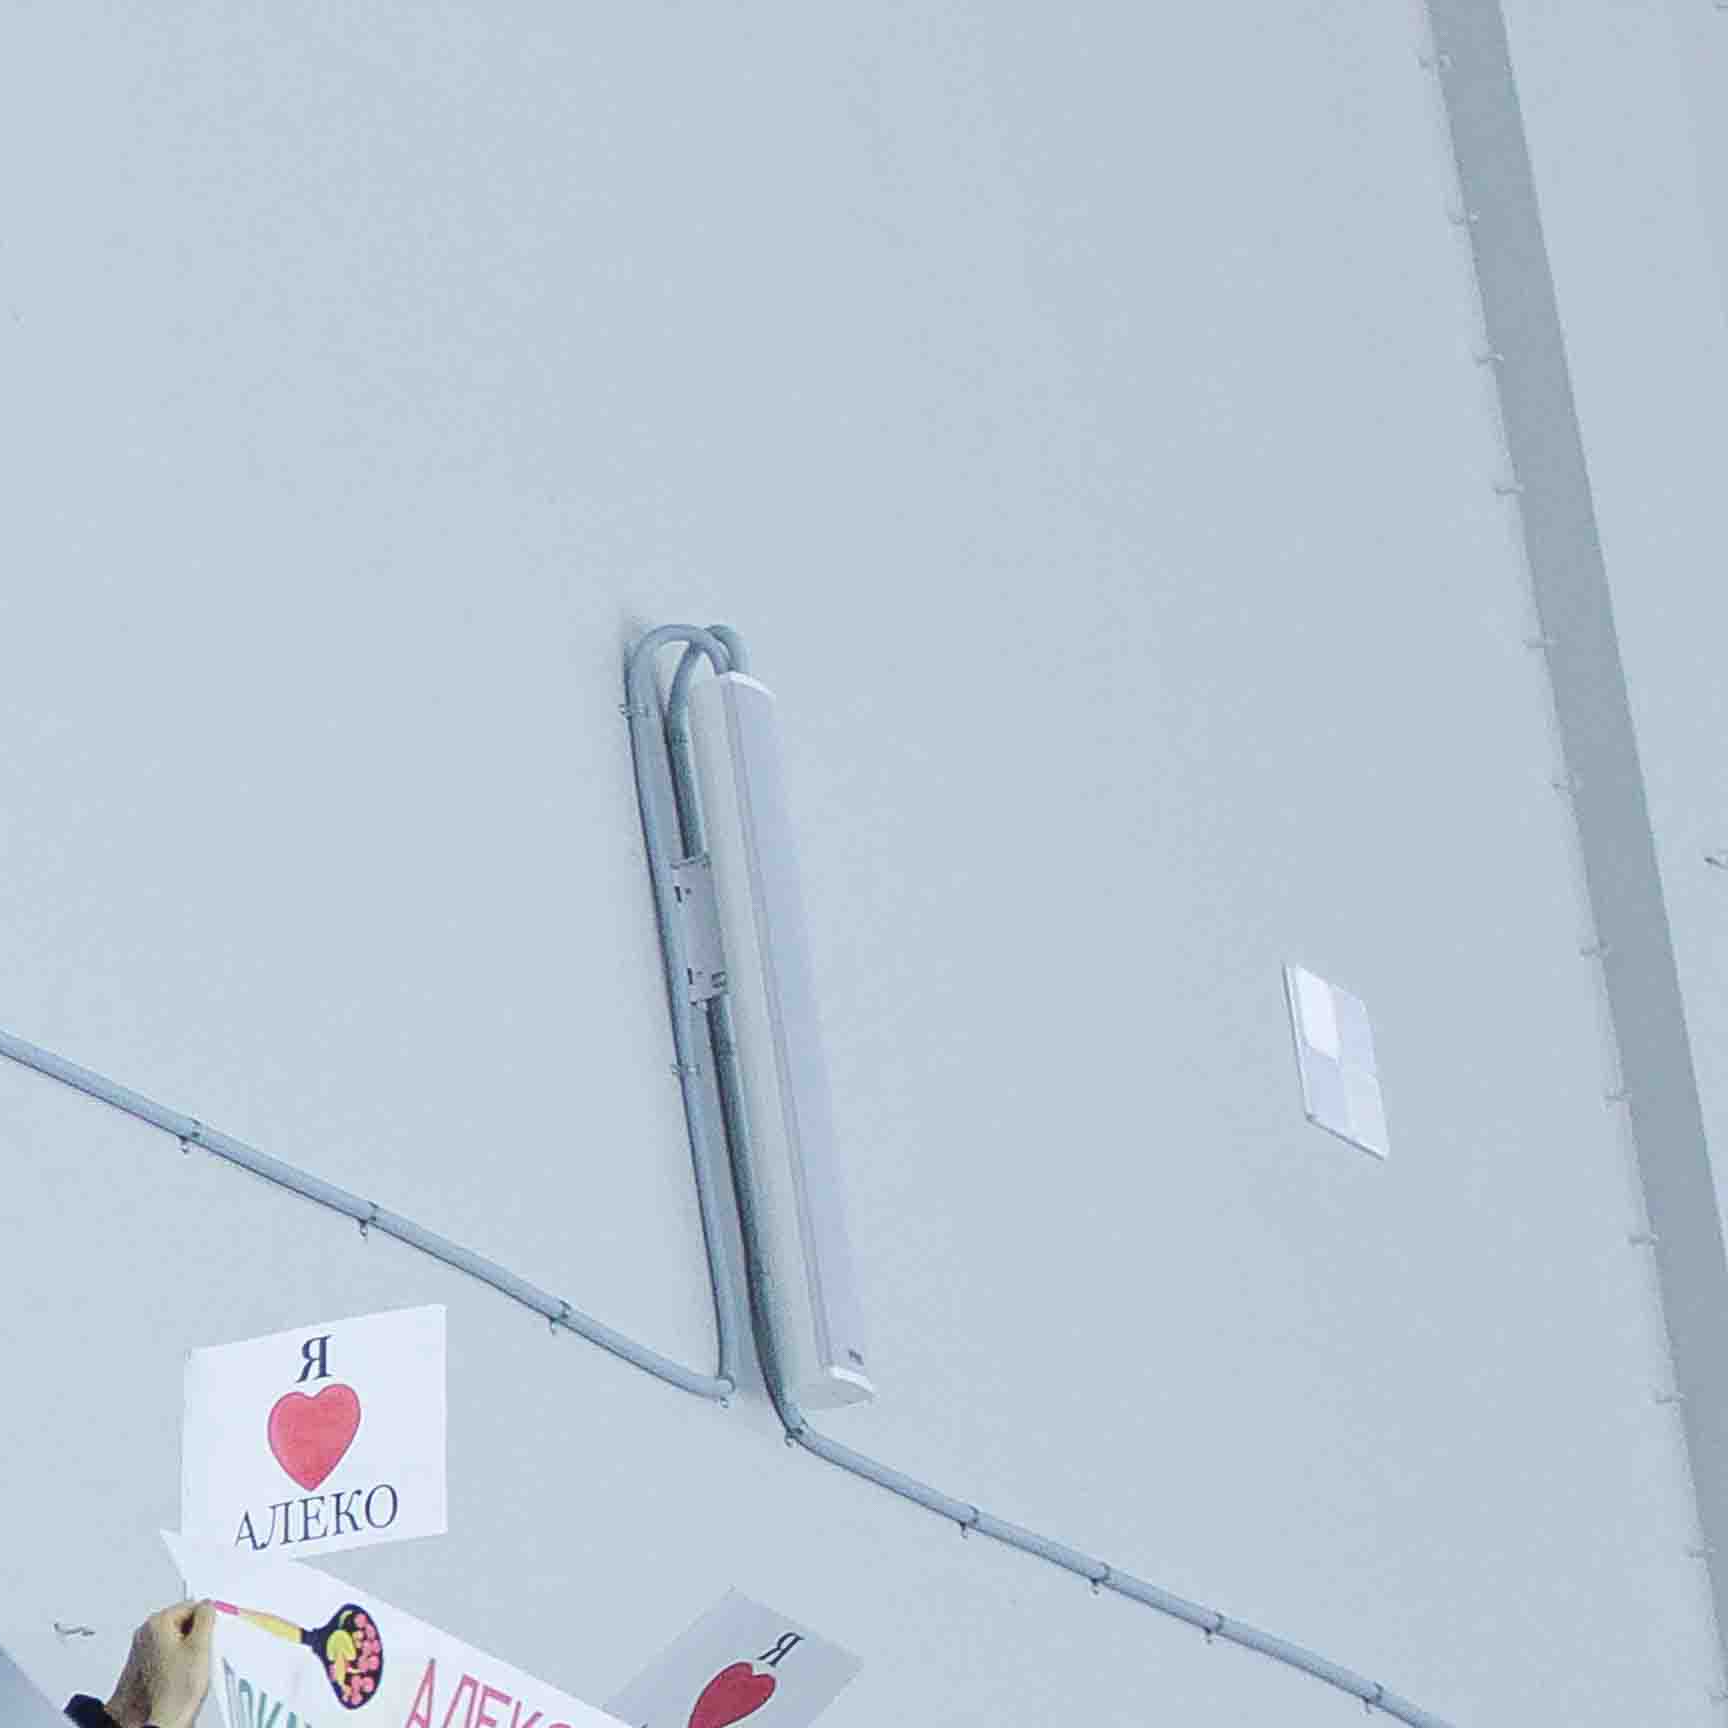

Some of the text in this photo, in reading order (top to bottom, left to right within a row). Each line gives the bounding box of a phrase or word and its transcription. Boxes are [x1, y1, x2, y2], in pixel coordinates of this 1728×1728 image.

[295, 1335, 334, 1383] Я
[233, 1484, 400, 1552] АЛЕКО
[756, 1631, 805, 1667] Я
